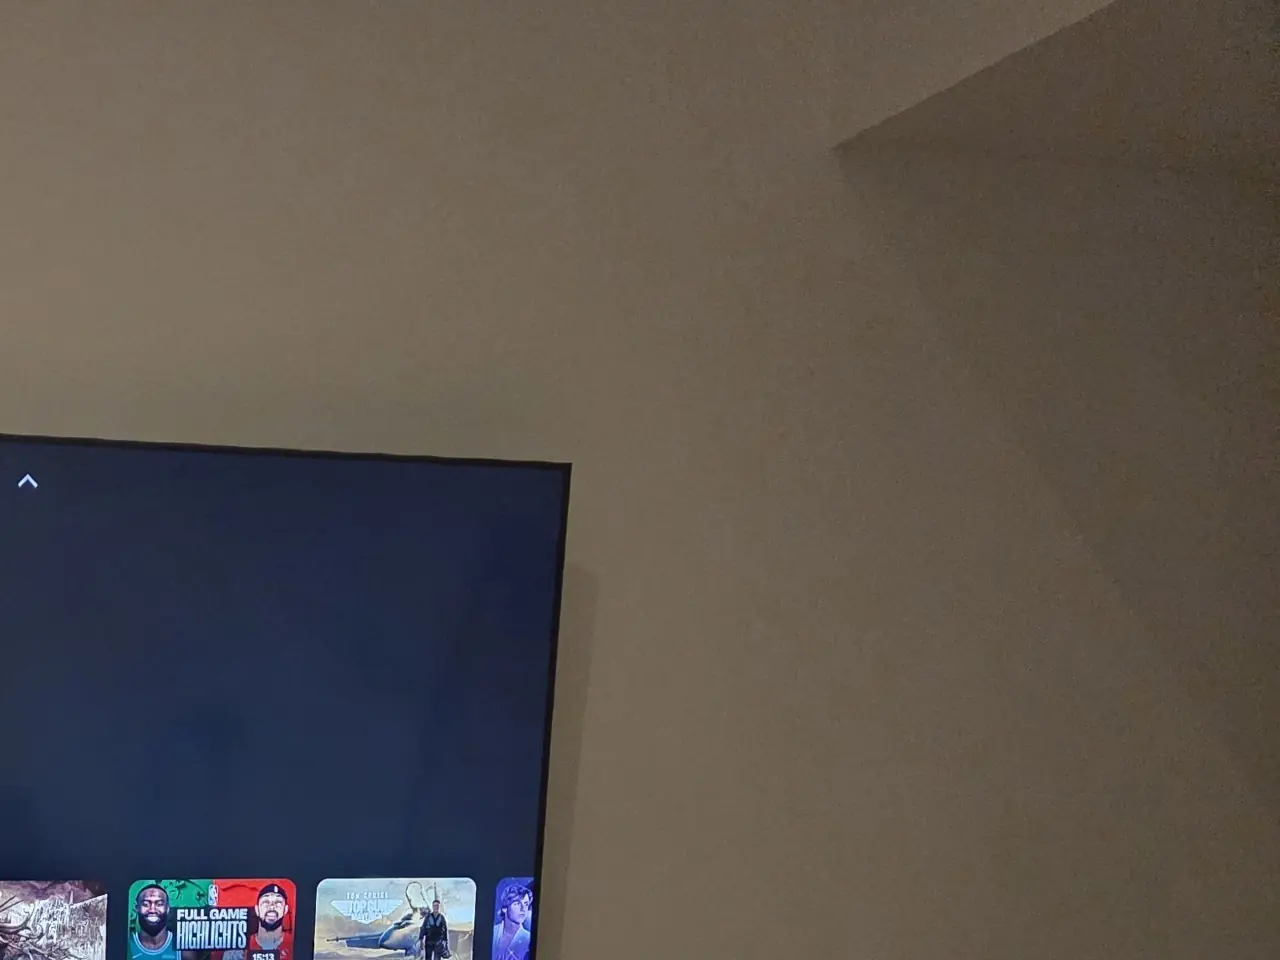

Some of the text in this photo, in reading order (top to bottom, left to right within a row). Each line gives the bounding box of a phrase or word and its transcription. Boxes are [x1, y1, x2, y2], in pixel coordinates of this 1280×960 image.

[176, 908, 248, 920] FULL GAME
[176, 920, 247, 950] HIGHLIGHTS
